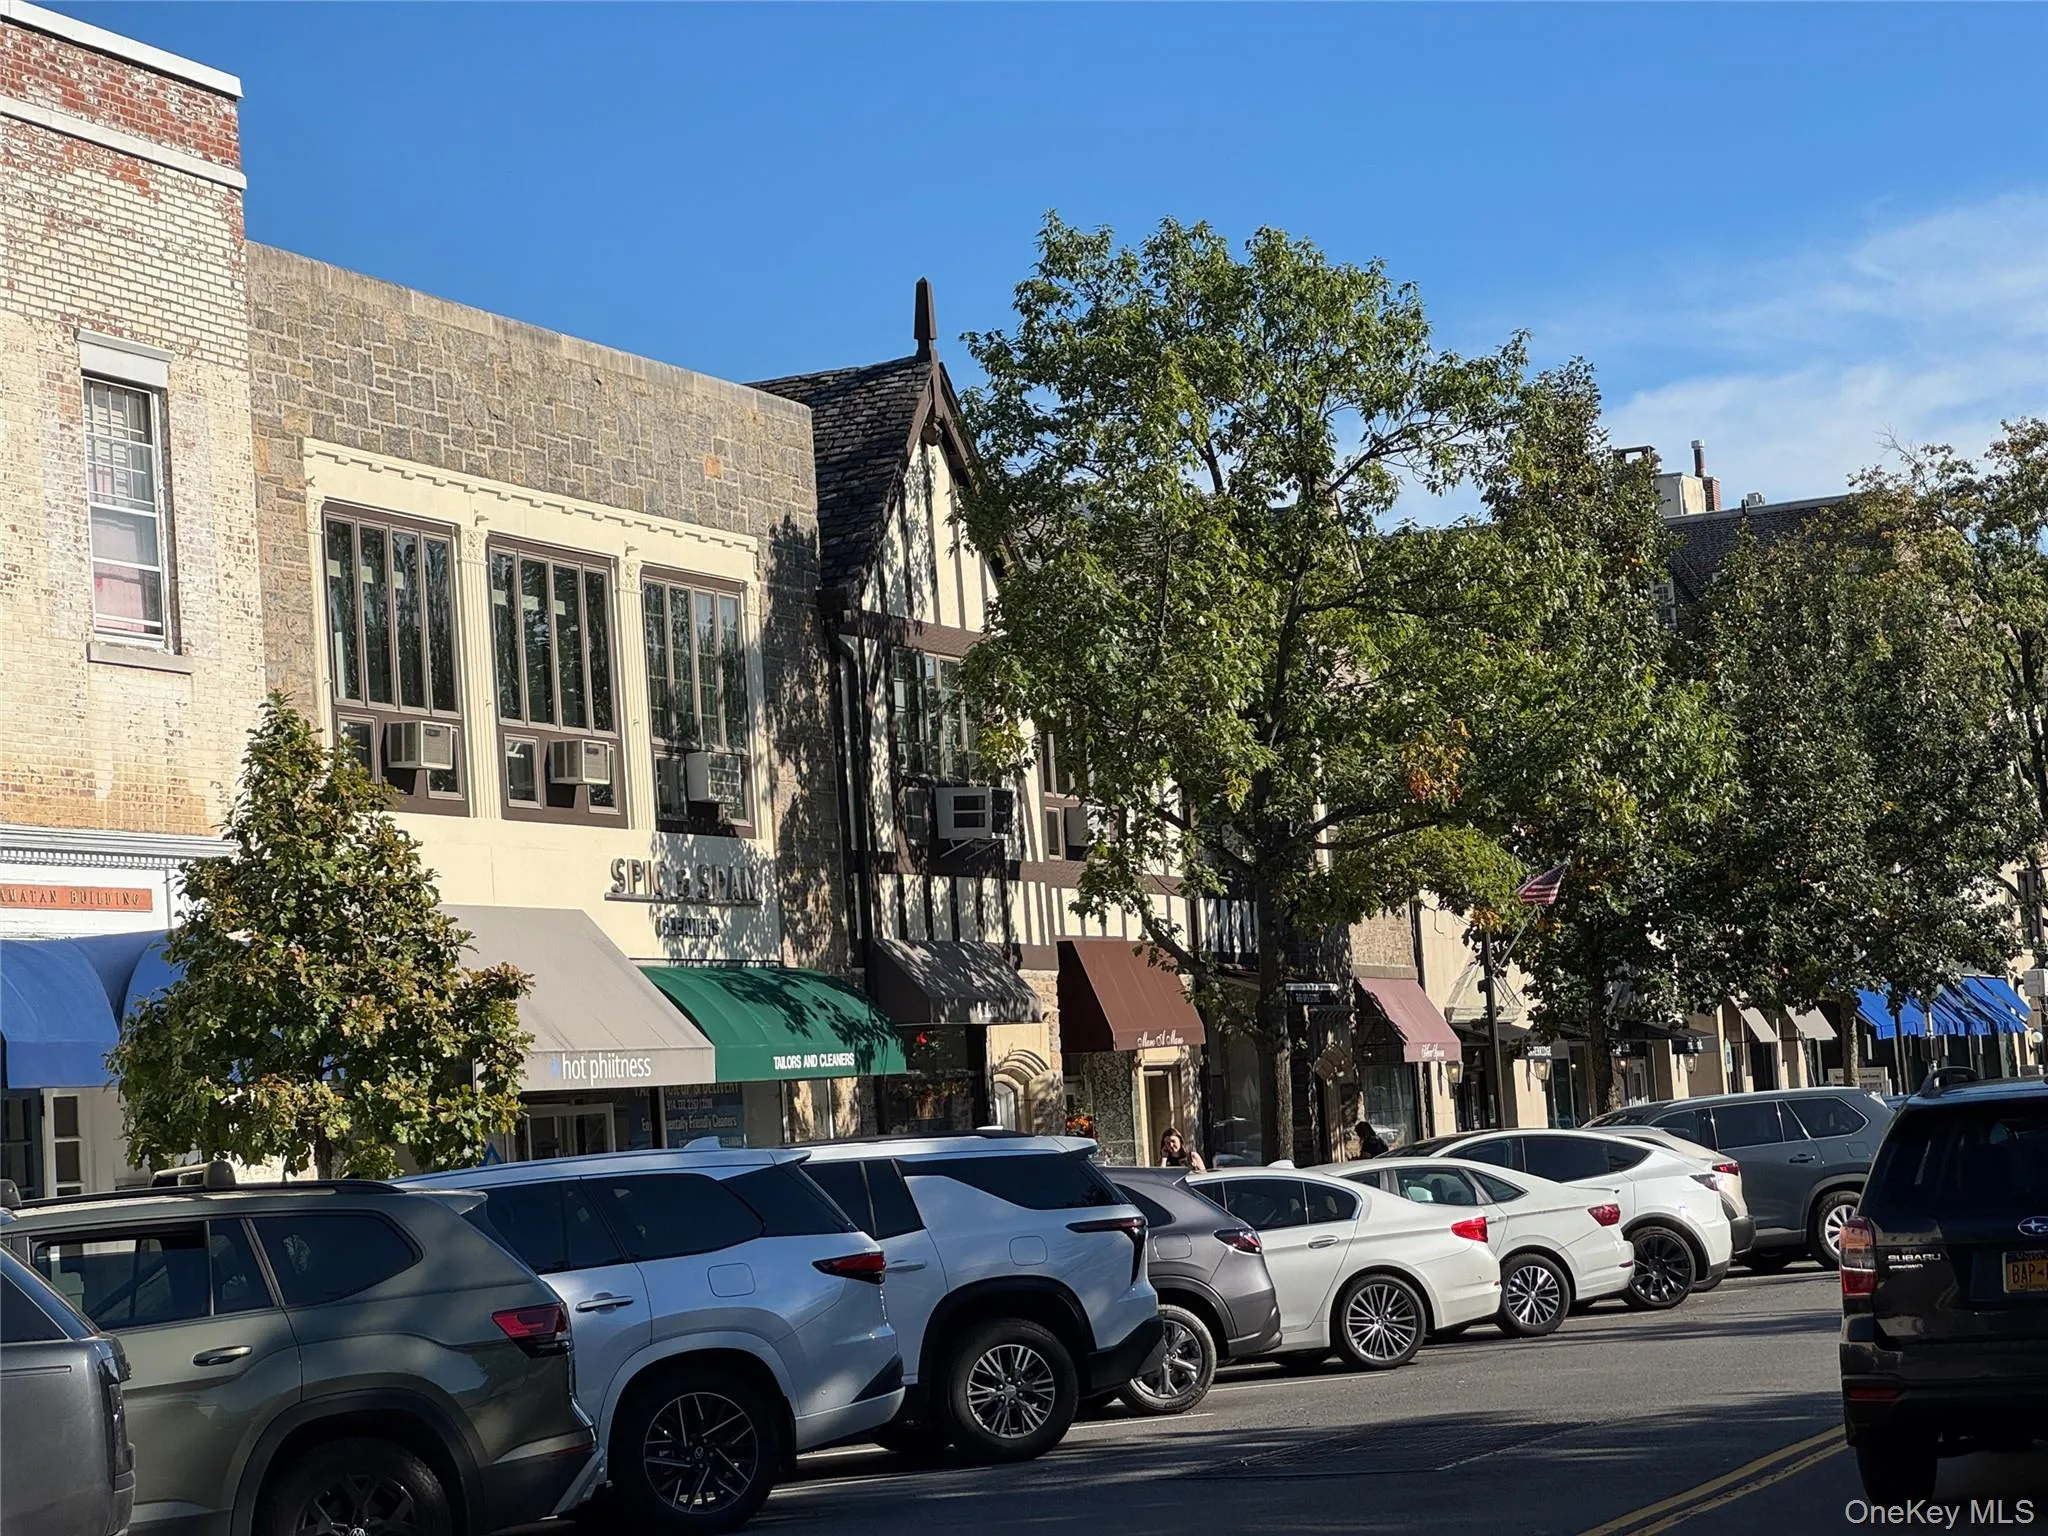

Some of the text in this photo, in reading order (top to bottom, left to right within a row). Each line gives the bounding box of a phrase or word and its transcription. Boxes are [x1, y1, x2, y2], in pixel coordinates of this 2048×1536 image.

[611, 858, 667, 898] SPIC
[697, 864, 757, 900] SPAN
[70, 890, 140, 905] BUILDING
[656, 917, 720, 937] CLEANERS
[562, 1052, 651, 1087] hot phiitness
[773, 1052, 855, 1070] TAILORS AND CLEANERS
[1888, 1253, 1941, 1261] SUBARU
[2012, 1263, 2048, 1284] BAP
